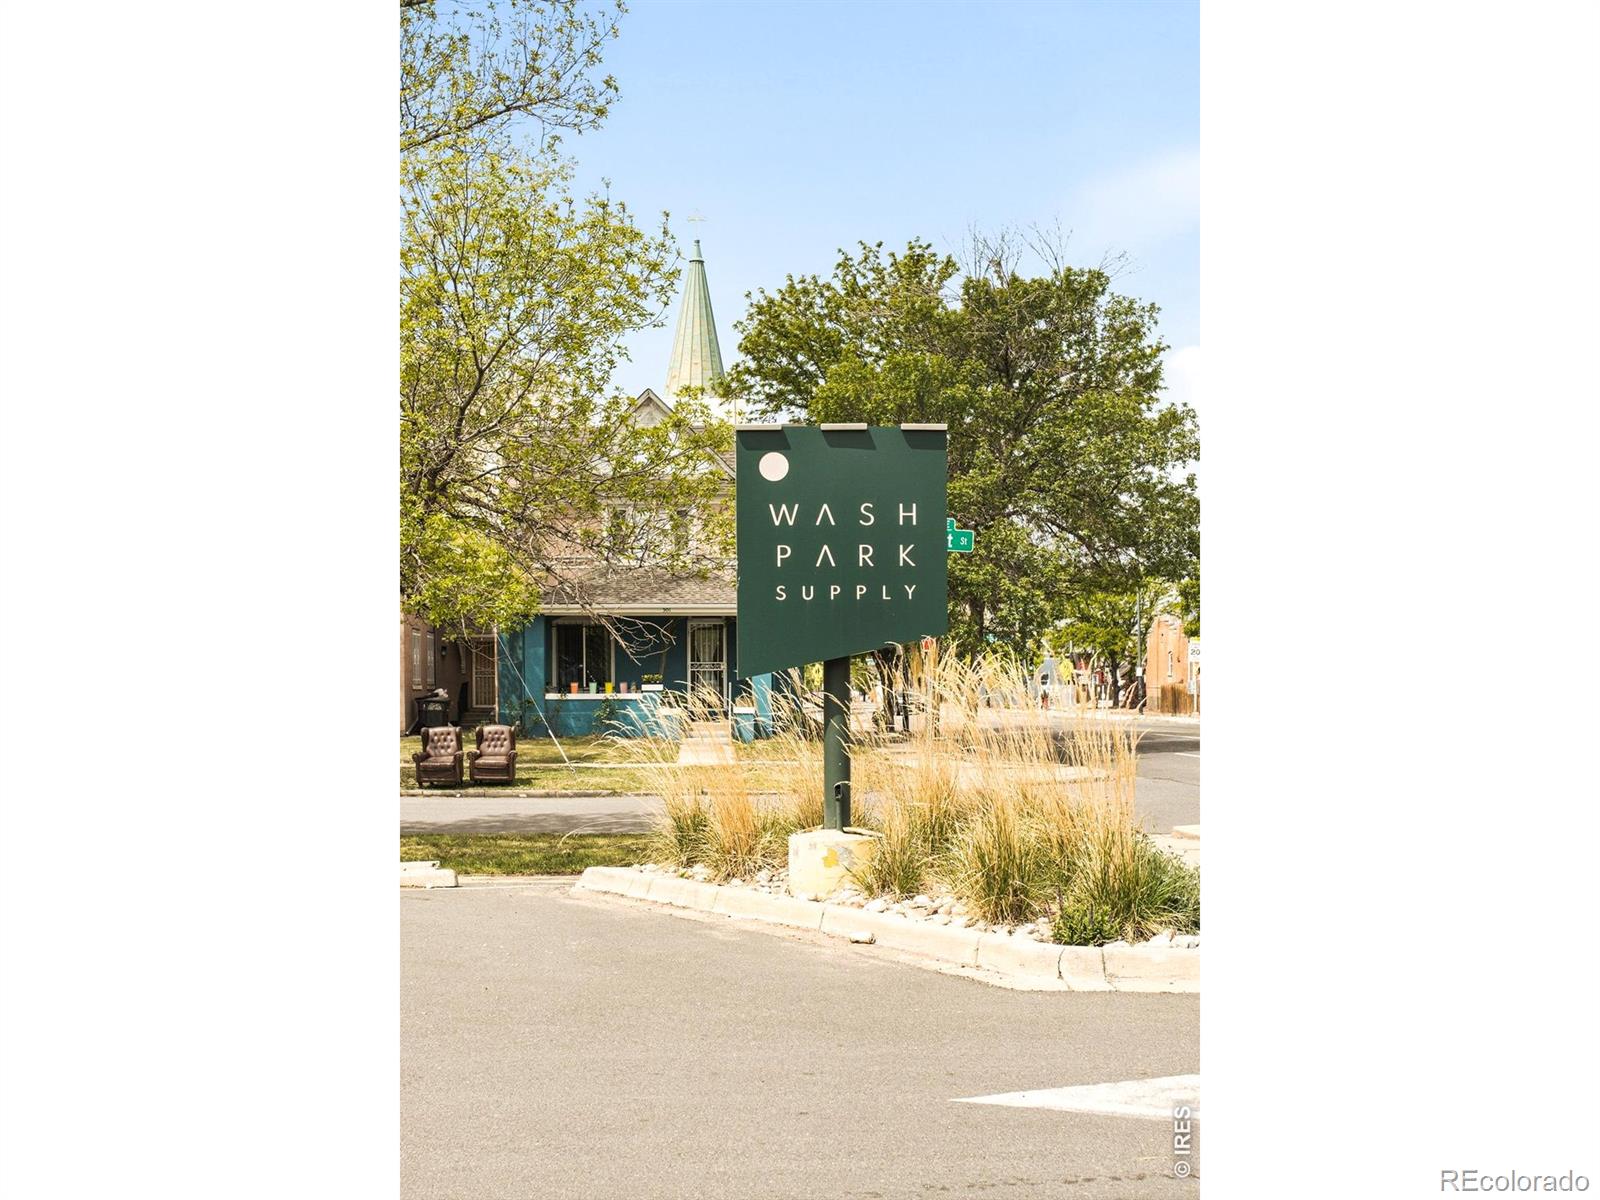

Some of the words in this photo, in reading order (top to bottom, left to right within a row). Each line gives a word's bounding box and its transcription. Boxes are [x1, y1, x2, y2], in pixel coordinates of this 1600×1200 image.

[768, 503, 918, 527] WASH
[960, 537, 968, 545] St
[776, 544, 917, 568] PARK
[775, 584, 917, 601] SUPPLY
